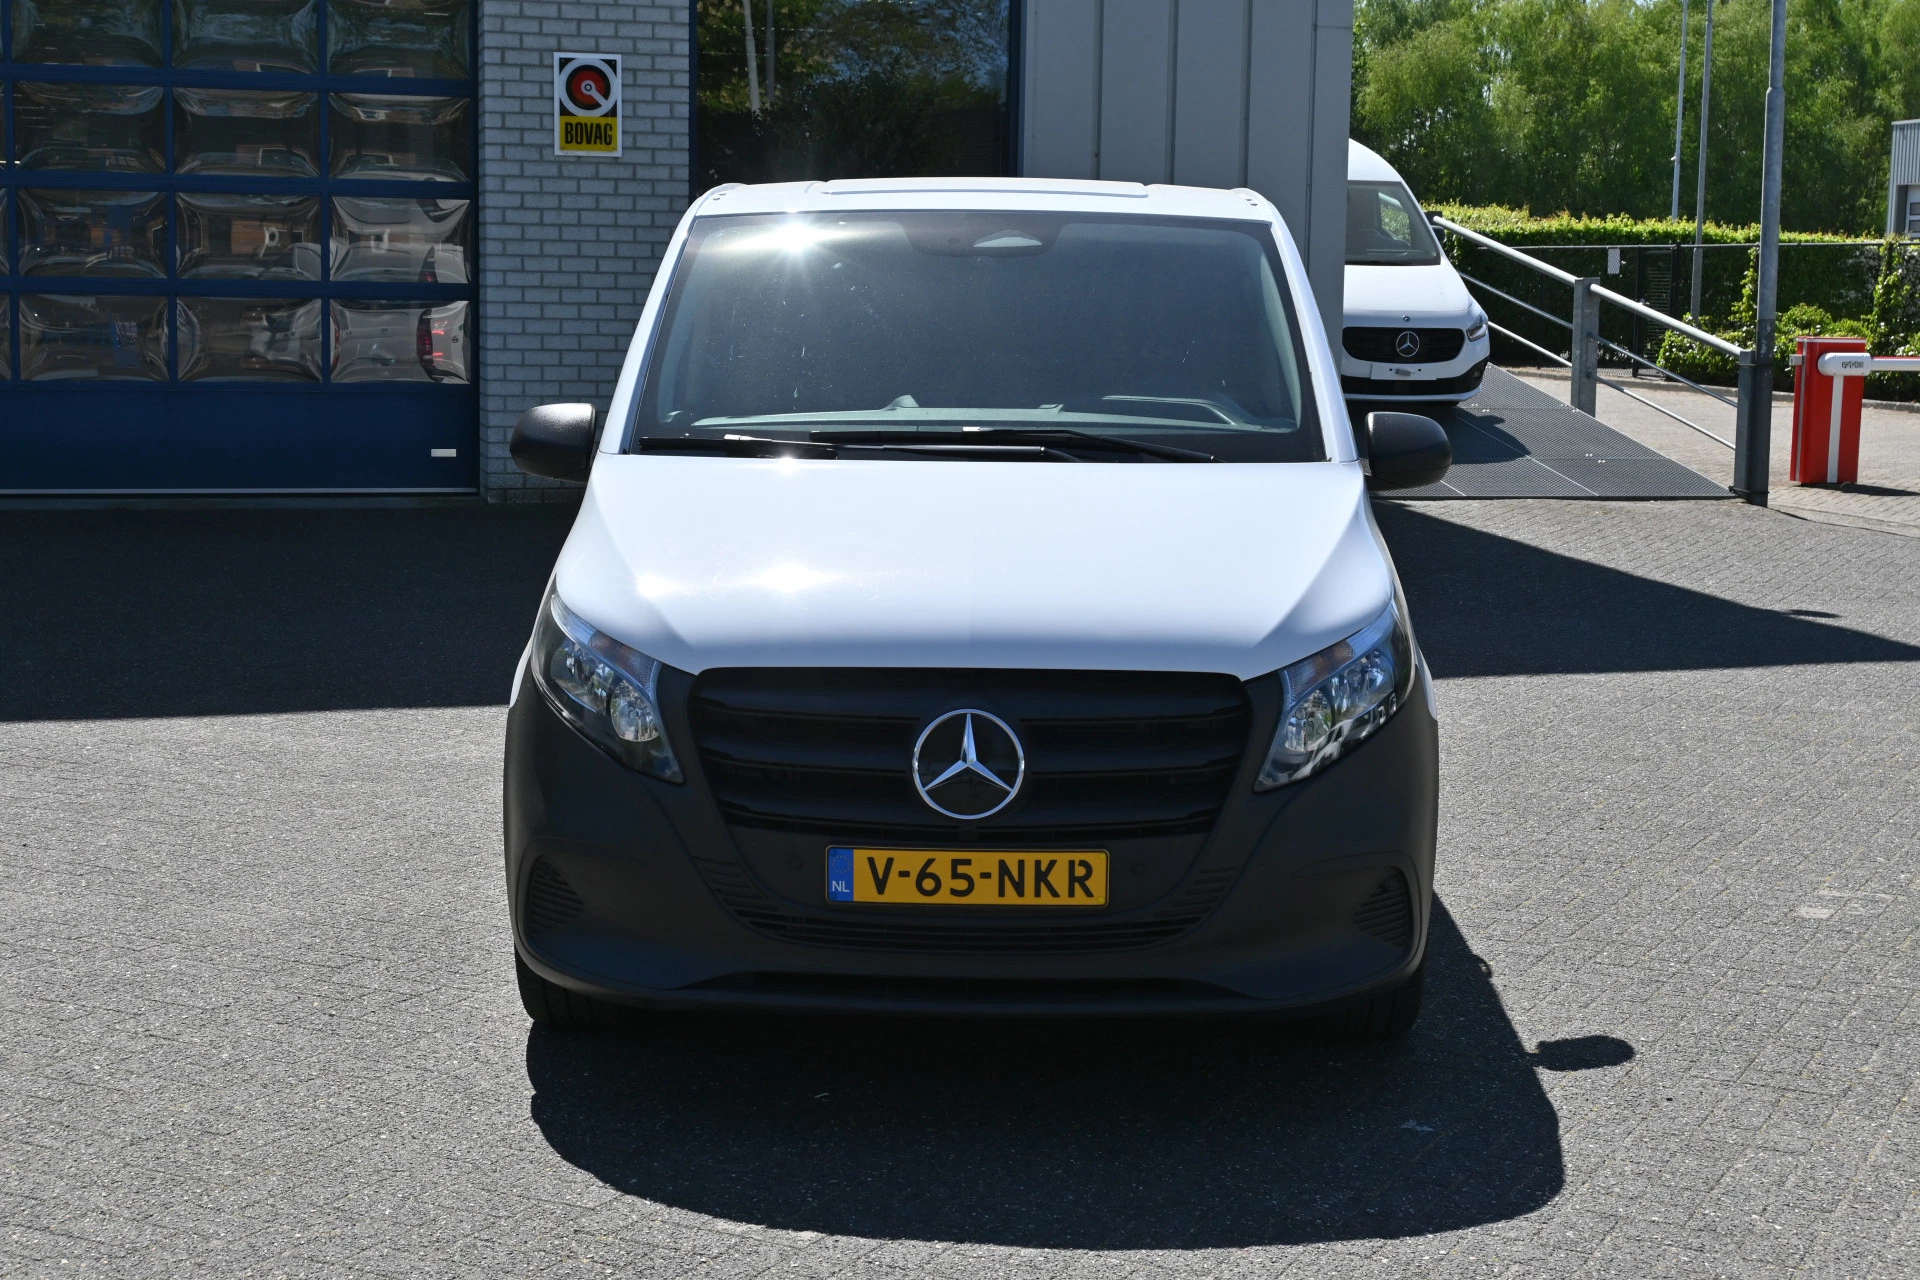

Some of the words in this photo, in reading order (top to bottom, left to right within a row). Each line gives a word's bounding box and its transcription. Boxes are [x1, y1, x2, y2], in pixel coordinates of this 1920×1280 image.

[565, 122, 613, 146] BOVAG
[832, 880, 850, 892] NL
[867, 856, 1094, 898] V-65-NKR
